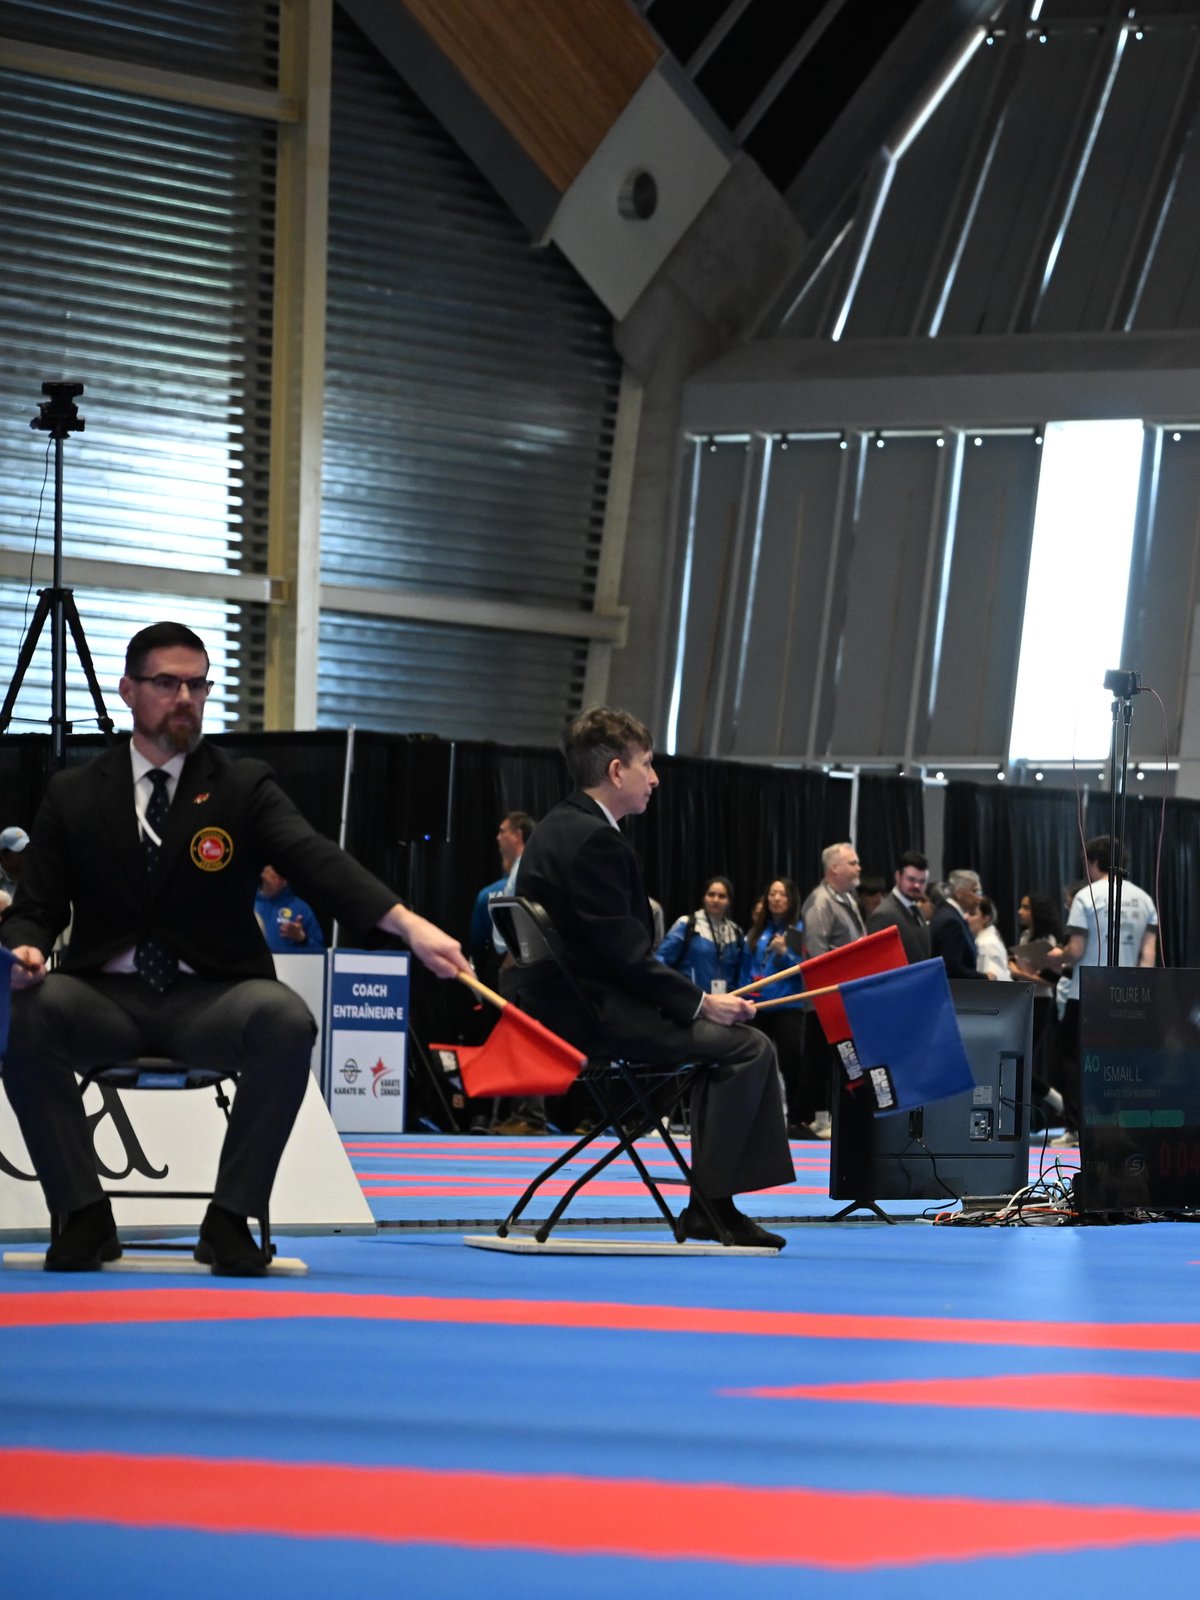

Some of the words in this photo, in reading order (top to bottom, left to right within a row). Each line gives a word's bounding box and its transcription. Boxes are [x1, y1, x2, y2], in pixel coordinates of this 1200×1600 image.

[352, 983, 388, 997] COACH
[1084, 1055, 1100, 1073] AO
[1103, 1065, 1134, 1082] ISMAIL
[334, 1087, 357, 1096] KARATE
